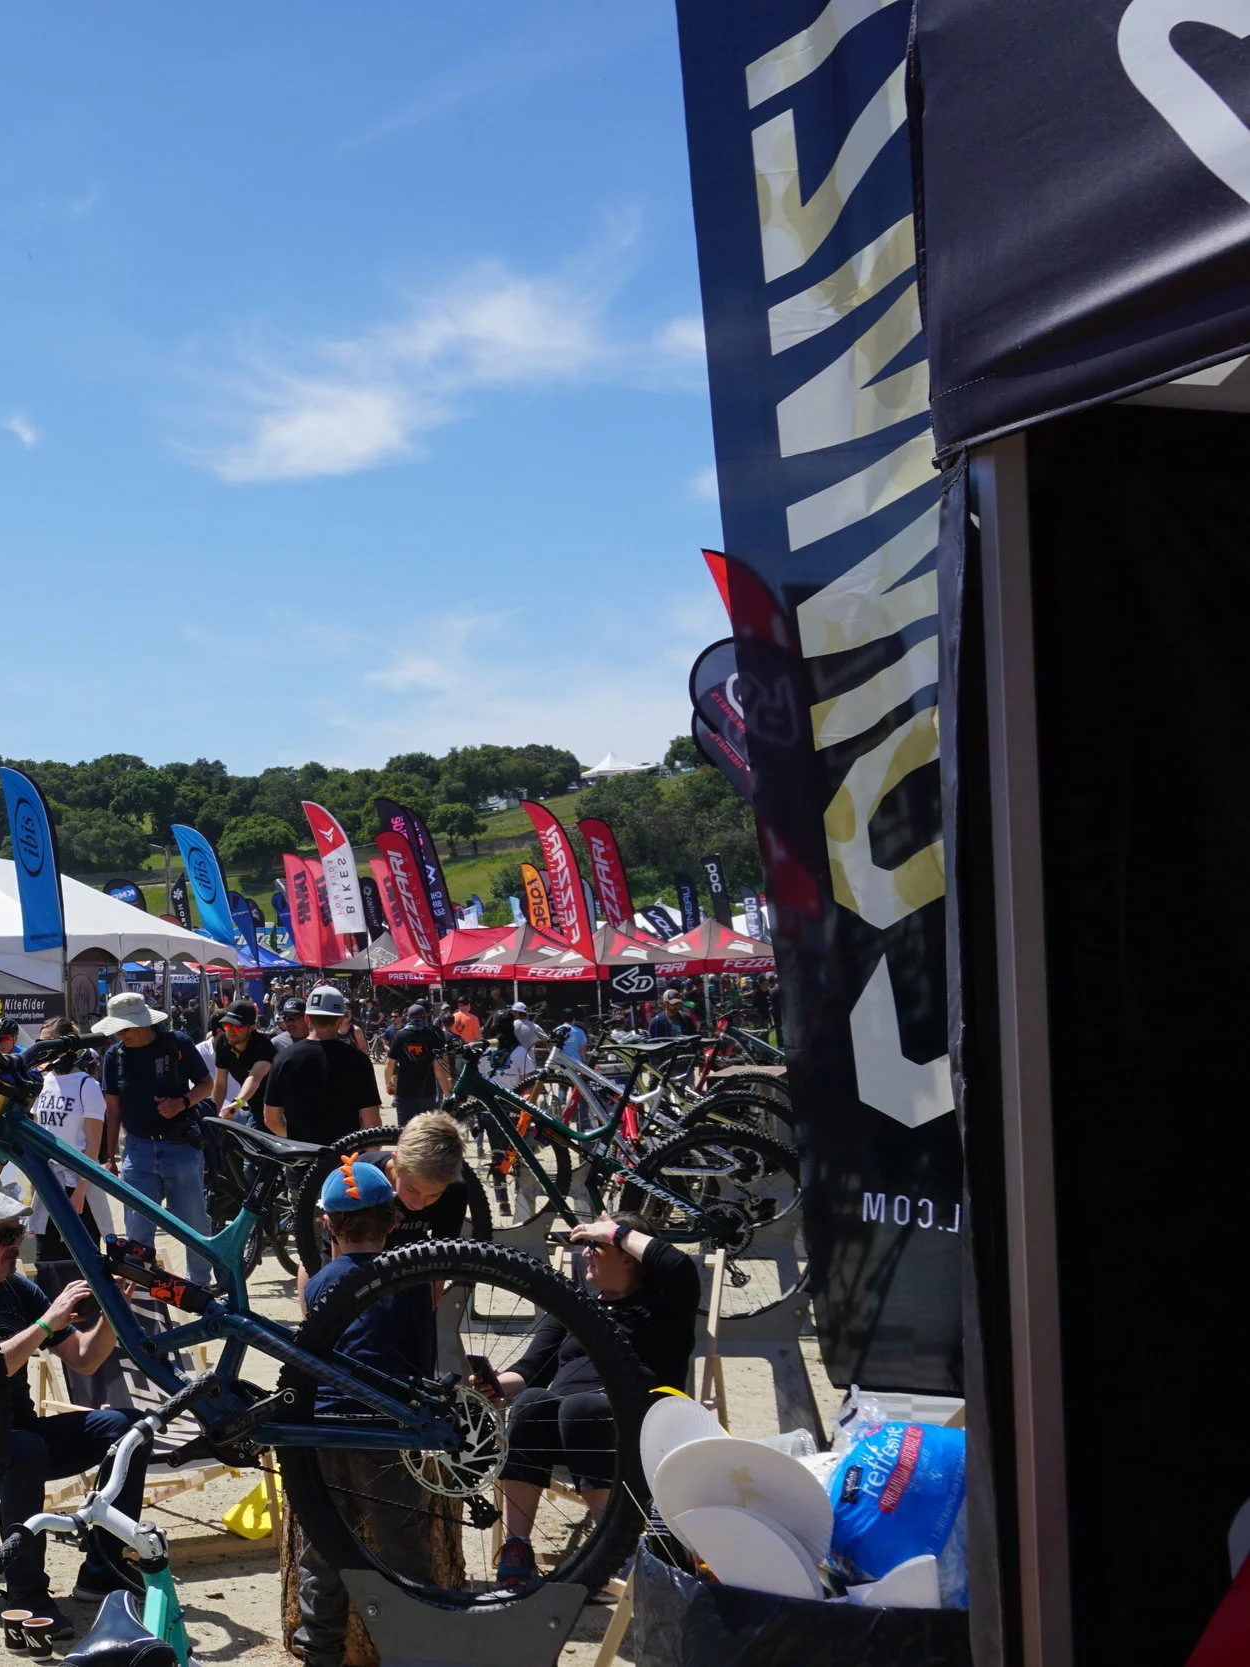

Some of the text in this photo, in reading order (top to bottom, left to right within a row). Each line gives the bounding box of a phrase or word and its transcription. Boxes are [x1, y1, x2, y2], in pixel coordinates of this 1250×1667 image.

[19, 815, 40, 858] ibis
[193, 858, 212, 891] ibis
[386, 849, 441, 967] FEZZARI
[388, 972, 425, 981] PREVELO
[452, 964, 502, 975] FEZZARI
[527, 966, 584, 978] FEZZARI
[4, 998, 46, 1011] NiteRider
[39, 1094, 76, 1112] RACE
[40, 1110, 68, 1127] DAY
[616, 1169, 702, 1219] COMMENCAL
[880, 1465, 914, 1510] PREMIUM
